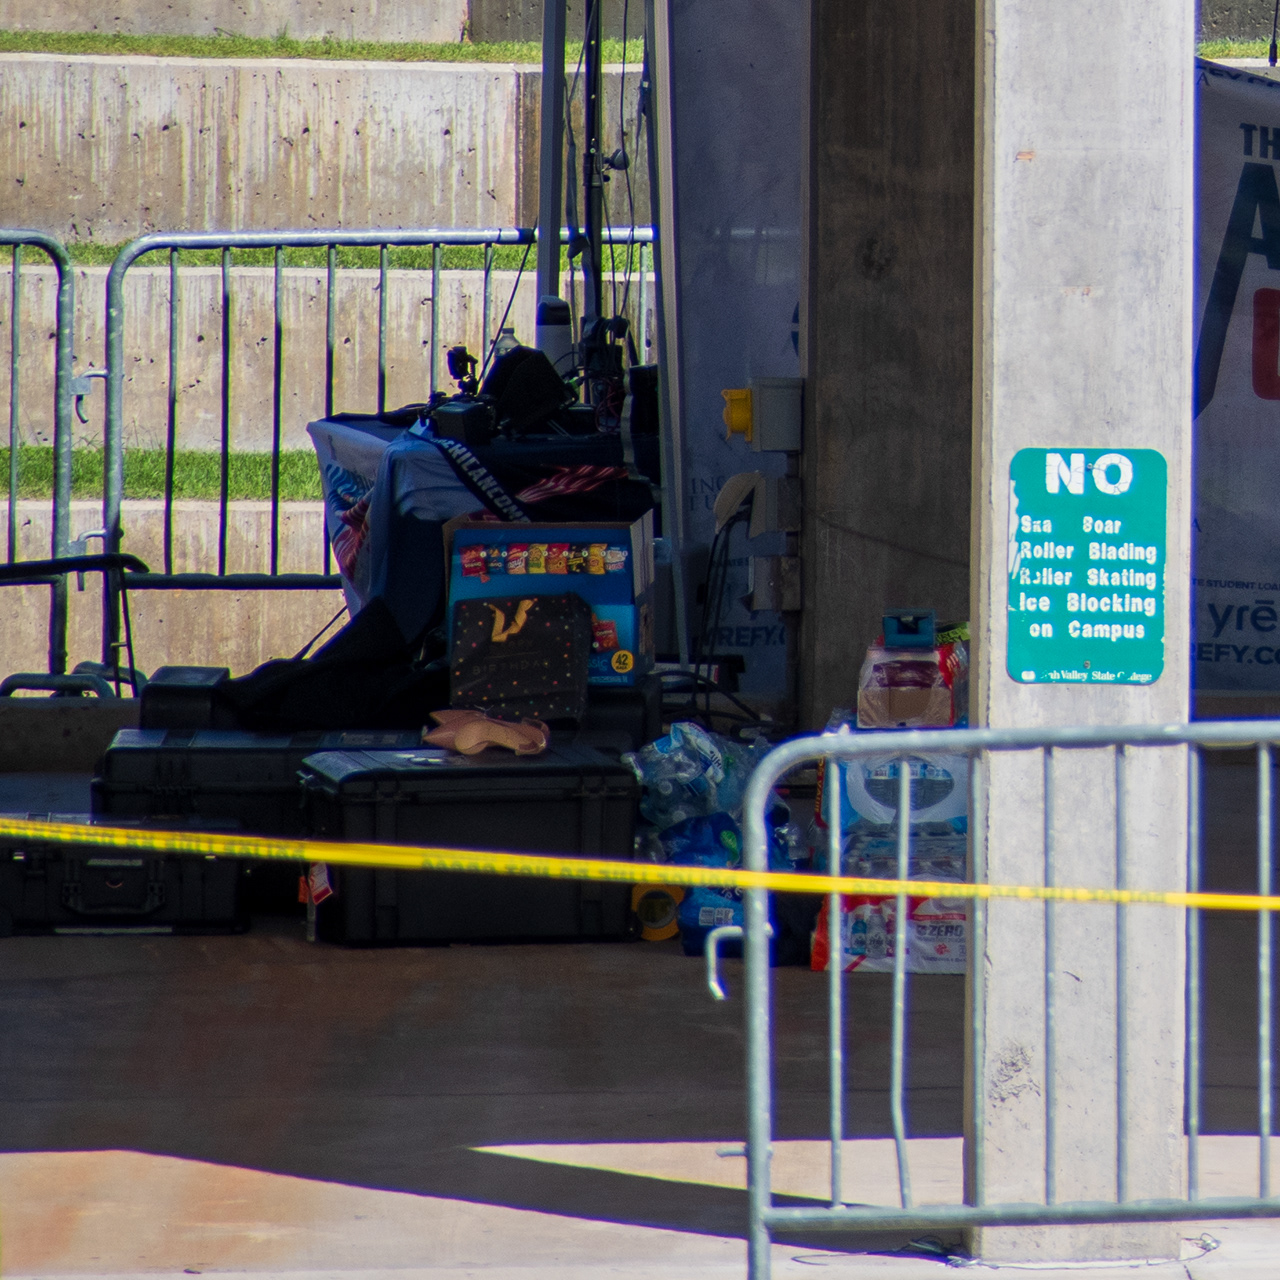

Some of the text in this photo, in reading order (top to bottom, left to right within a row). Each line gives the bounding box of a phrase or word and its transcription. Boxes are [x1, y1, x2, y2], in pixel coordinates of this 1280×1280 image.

[1045, 452, 1134, 496] NO
[1020, 541, 1158, 565] Roller Blading
[1087, 567, 1157, 590] Skating
[1206, 579, 1255, 591] STUDENT
[1020, 592, 1157, 616] Ice Blocking
[1029, 620, 1146, 642] on Campus
[615, 653, 629, 666] 42
[1061, 670, 1088, 681] Valley
[1092, 671, 1116, 680] State
